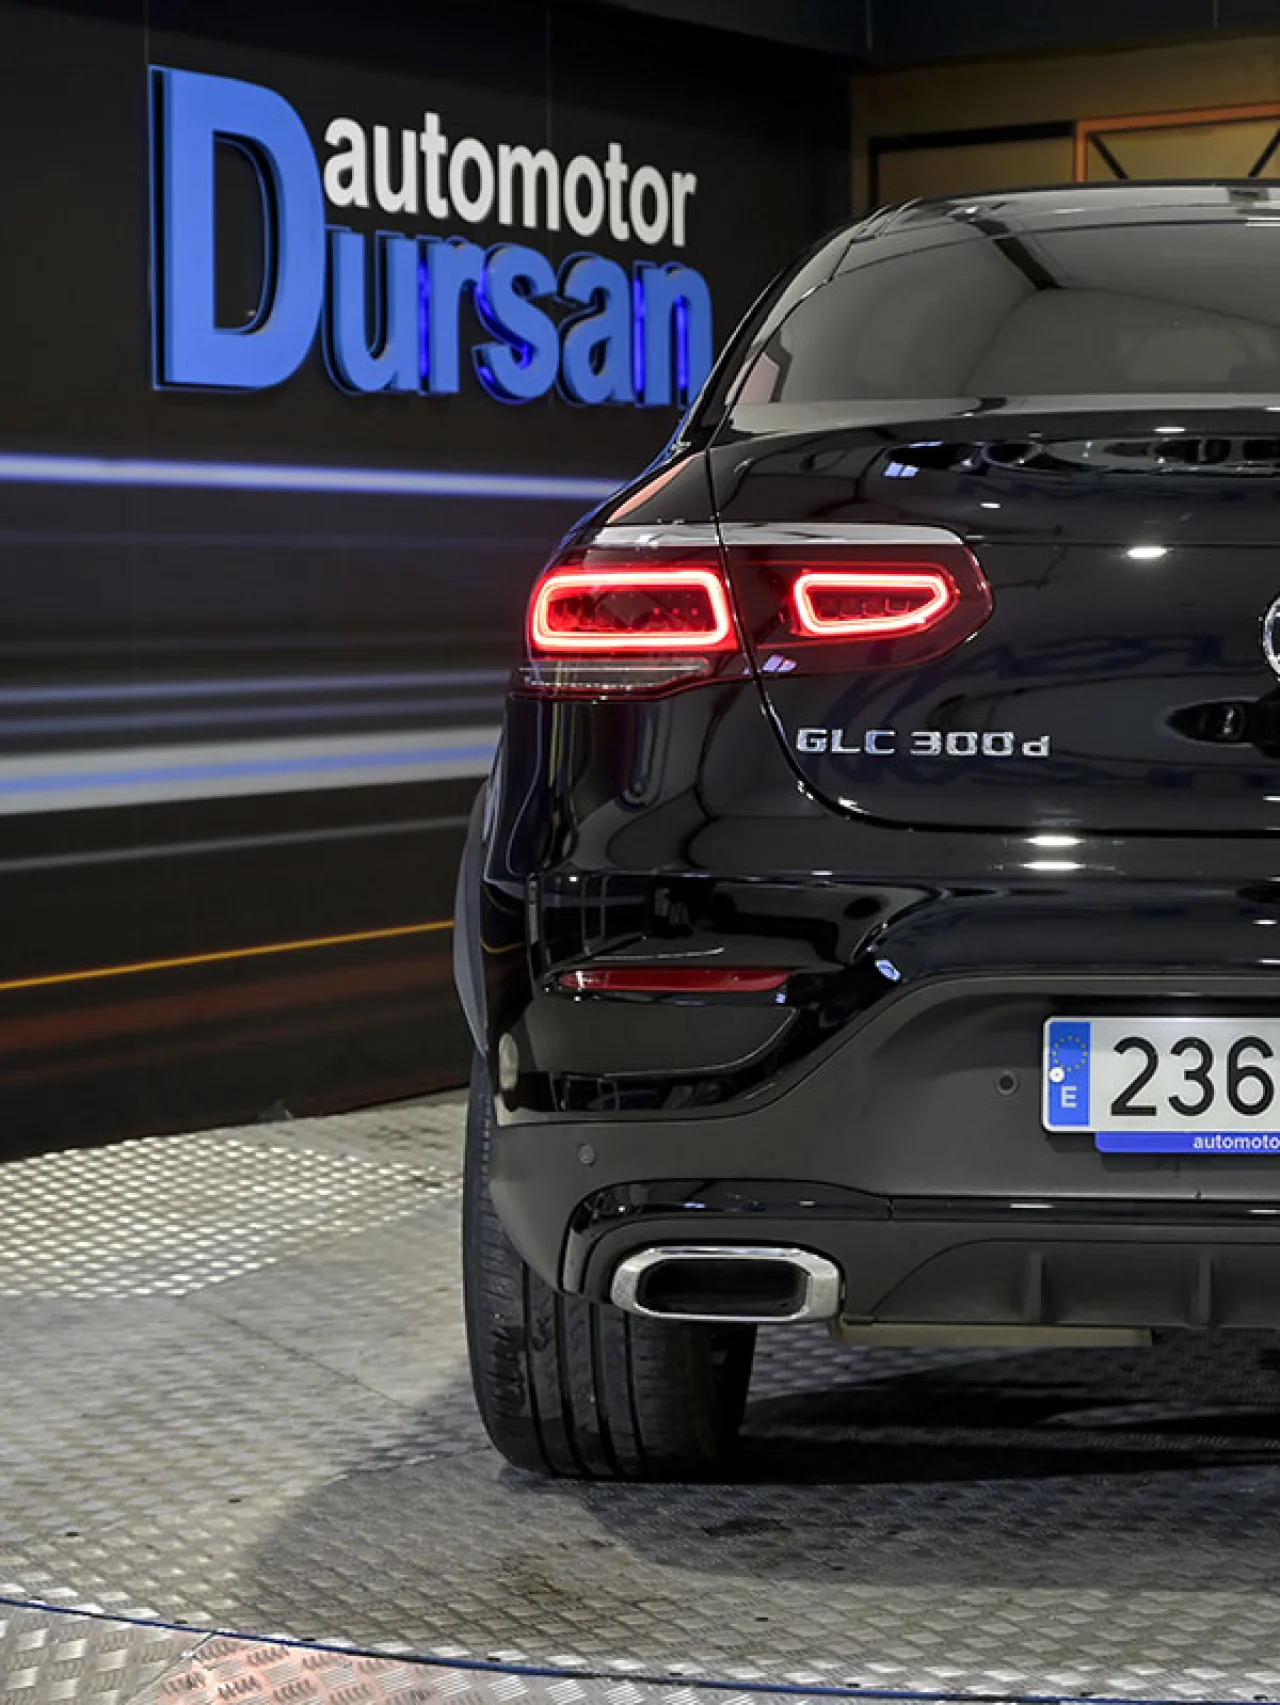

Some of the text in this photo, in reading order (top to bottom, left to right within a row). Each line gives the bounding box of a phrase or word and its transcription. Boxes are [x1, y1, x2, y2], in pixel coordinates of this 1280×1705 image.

[323, 112, 697, 247] automotor
[149, 64, 712, 409] Dursan
[796, 729, 896, 754] GLC
[1060, 1085, 1078, 1108] E
